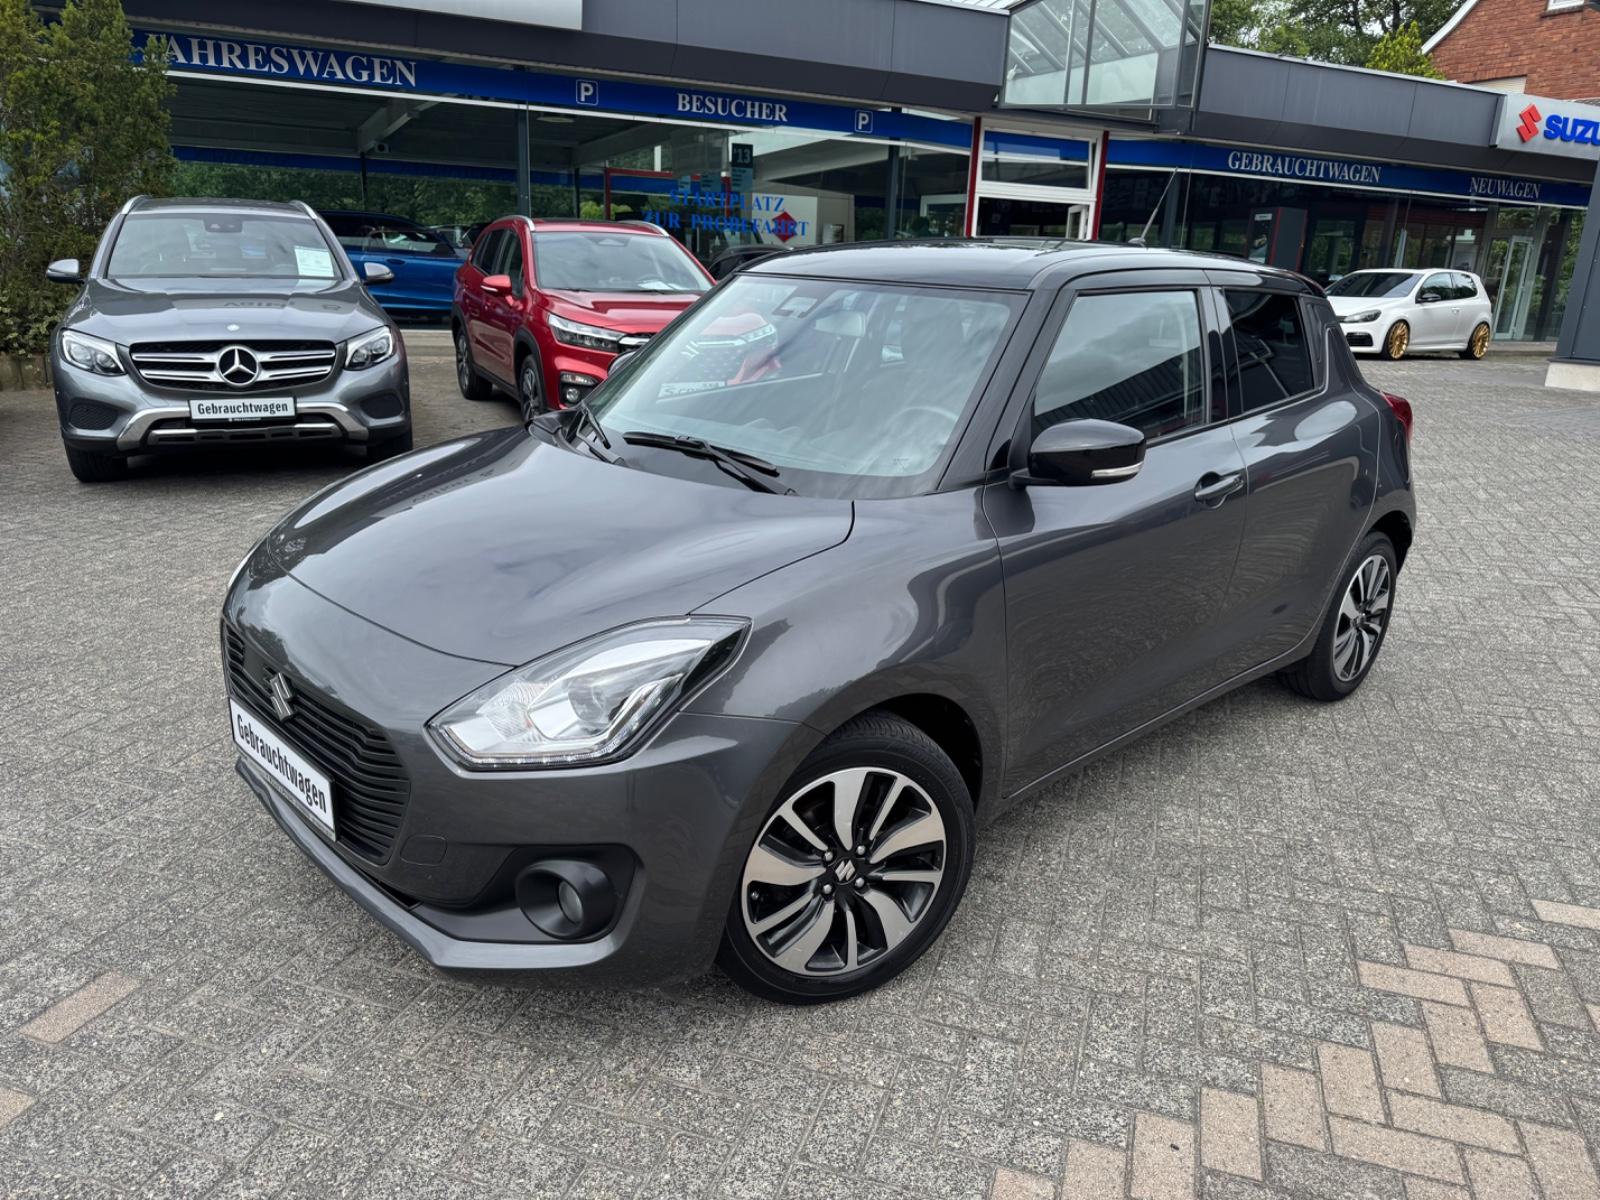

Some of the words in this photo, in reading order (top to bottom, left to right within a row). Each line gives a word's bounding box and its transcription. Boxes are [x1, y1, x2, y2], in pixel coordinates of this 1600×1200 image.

[145, 33, 417, 87] AHRESWAGEN
[677, 92, 788, 122] BESUCHER
[1228, 150, 1382, 183] GEBRAUCHTWAGEN
[670, 189, 785, 213] STARTPLATZ
[1469, 177, 1541, 199] NEUWAGEN
[197, 402, 288, 415] Gebrauchtwagen
[237, 713, 327, 814] Gebrauchtwagen
